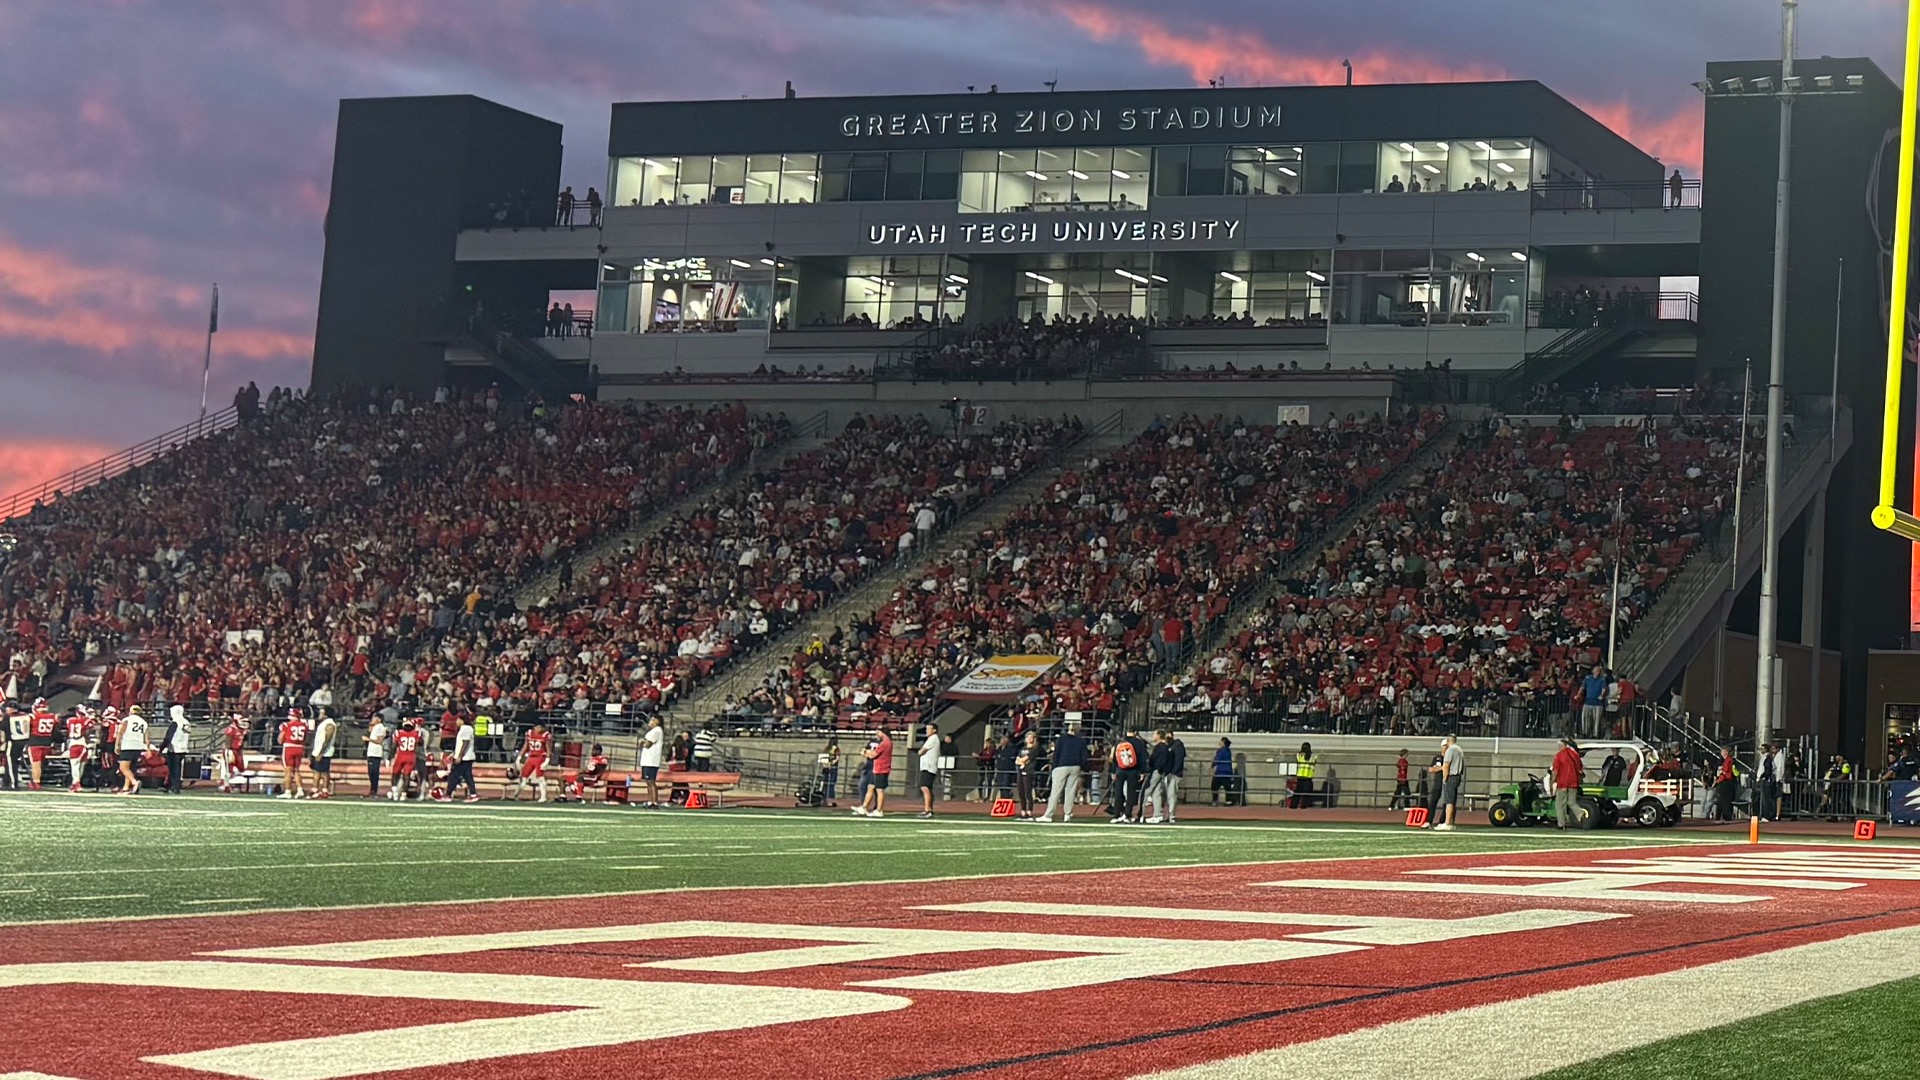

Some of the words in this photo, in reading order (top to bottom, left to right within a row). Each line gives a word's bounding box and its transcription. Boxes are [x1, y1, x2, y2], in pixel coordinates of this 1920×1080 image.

[839, 111, 999, 137] GREATER
[1014, 109, 1101, 134] ZION
[1119, 105, 1284, 131] STADIUM
[868, 224, 947, 245] UTAH
[960, 222, 1038, 244] TECH
[1052, 219, 1242, 242] UNIVERSITY
[38, 719, 54, 733] 65
[131, 722, 146, 733] 24
[290, 726, 305, 741] 35
[399, 736, 416, 752] 38
[992, 800, 1009, 815] 20
[1408, 808, 1424, 824] 10
[1857, 821, 1871, 837] G
